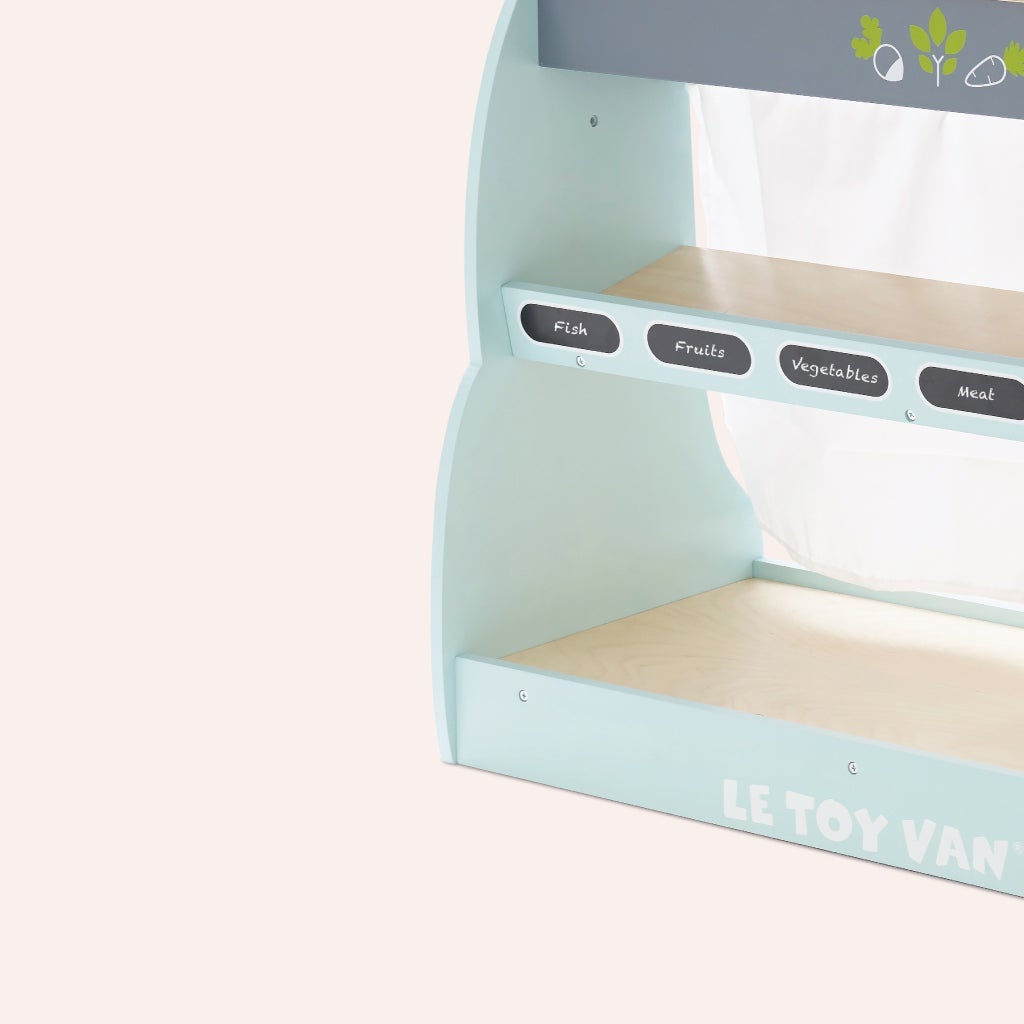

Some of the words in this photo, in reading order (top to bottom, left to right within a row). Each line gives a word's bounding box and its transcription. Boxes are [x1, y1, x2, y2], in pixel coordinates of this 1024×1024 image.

[553, 320, 588, 337] Fish
[674, 340, 725, 359] Fruits
[791, 357, 879, 385] Vegetables
[957, 385, 996, 402] Meat
[723, 778, 774, 826] LE
[785, 790, 889, 853] TOY
